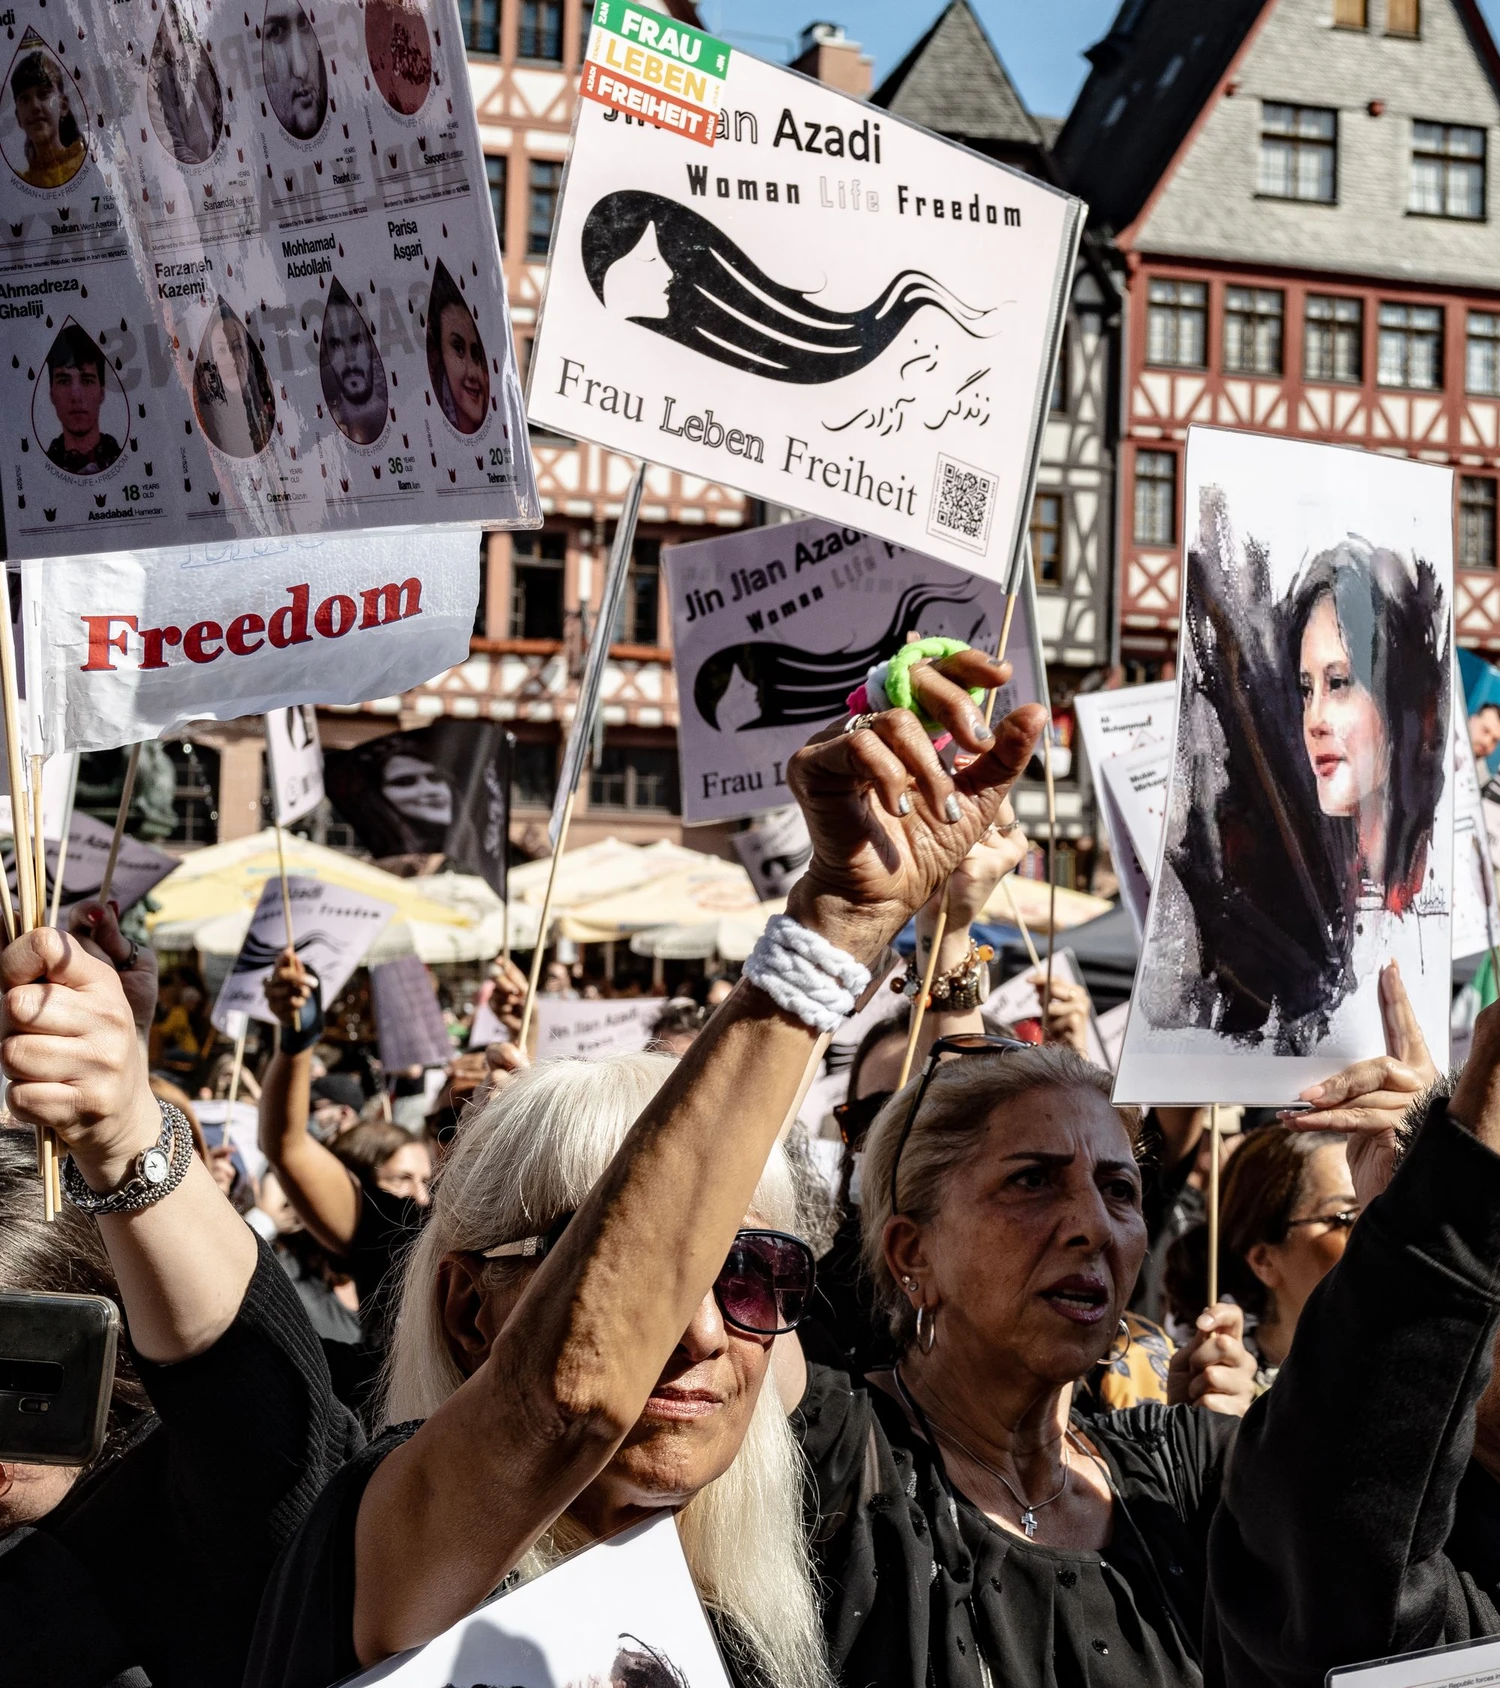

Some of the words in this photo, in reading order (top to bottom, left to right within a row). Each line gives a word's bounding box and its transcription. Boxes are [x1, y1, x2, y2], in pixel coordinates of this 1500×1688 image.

[598, 2, 610, 24] ZAN
[621, 9, 702, 63] FRAU
[606, 39, 707, 102] LEBEN
[716, 55, 726, 72] JIN
[597, 75, 703, 134] FREIHEIT
[705, 115, 715, 140] AZADI
[773, 107, 882, 164] Azadi
[686, 163, 801, 205] Woman
[819, 175, 881, 214] Life
[897, 185, 1023, 229] Freedom
[388, 218, 418, 238] Parisa
[154, 256, 213, 279] Farzaneh
[0, 279, 79, 299] Ahmadreza
[158, 278, 206, 299] Kazemi
[555, 355, 645, 424] Frau
[659, 398, 766, 464] Leben
[780, 435, 919, 518] Freiheit
[388, 457, 404, 475] 36
[489, 447, 504, 466] 20
[122, 484, 140, 501] 18
[684, 589, 725, 623] Jin
[730, 559, 788, 603] Jian
[795, 527, 870, 573] Azad
[746, 585, 824, 634] Woman
[80, 576, 423, 672] Freedom
[702, 772, 763, 799] Frau
[1475, 1672, 1495, 1683] forces
